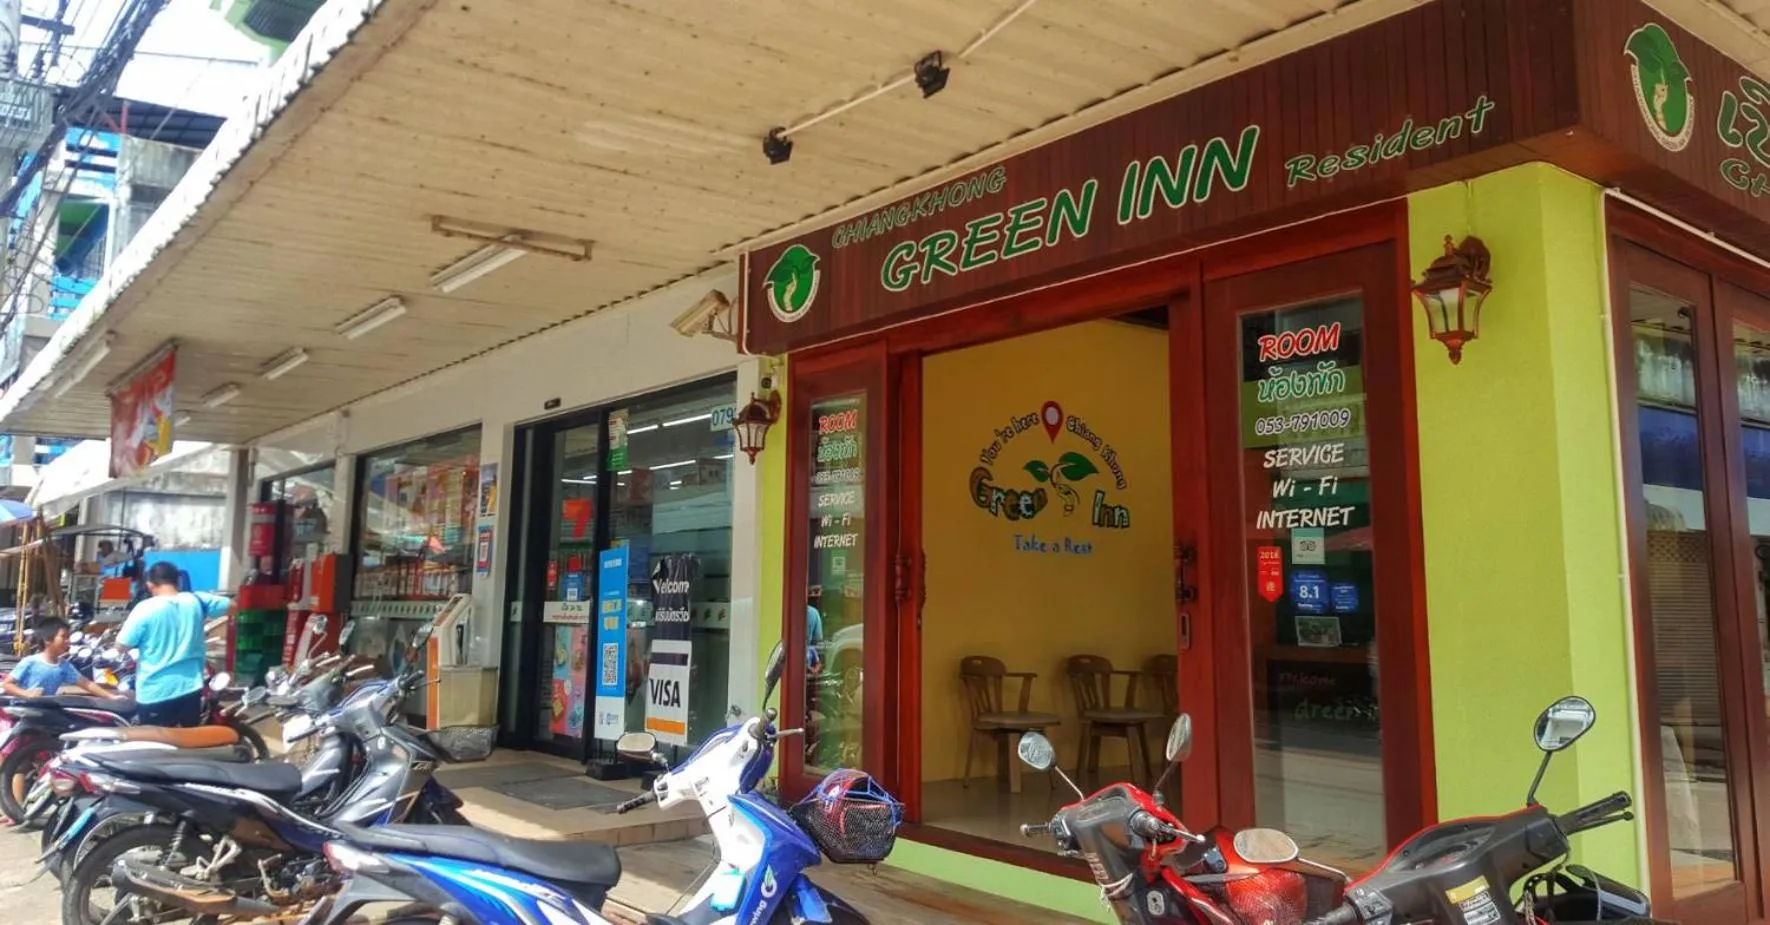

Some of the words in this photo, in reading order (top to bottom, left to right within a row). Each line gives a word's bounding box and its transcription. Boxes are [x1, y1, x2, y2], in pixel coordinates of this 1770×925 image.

[1285, 96, 1495, 188] Resident
[832, 166, 1006, 249] CHIANGKHONG
[881, 179, 1097, 291] GREEN
[1117, 125, 1260, 224] INN
[1258, 322, 1341, 362] ROOM
[1257, 361, 1345, 403] ห้องพัก
[712, 407, 736, 425] 079
[819, 409, 858, 435] ROOM
[1255, 408, 1351, 435] 053-791009
[1263, 443, 1344, 469] SERVICE
[818, 491, 855, 508] SERVICE
[969, 466, 1049, 521] Green
[1092, 490, 1130, 528] Inn
[1256, 506, 1355, 530] INTERNET
[814, 533, 858, 549] INTERNET
[1015, 534, 1046, 553] Take
[1299, 584, 1319, 599] 8.1
[650, 678, 681, 708] VISA
